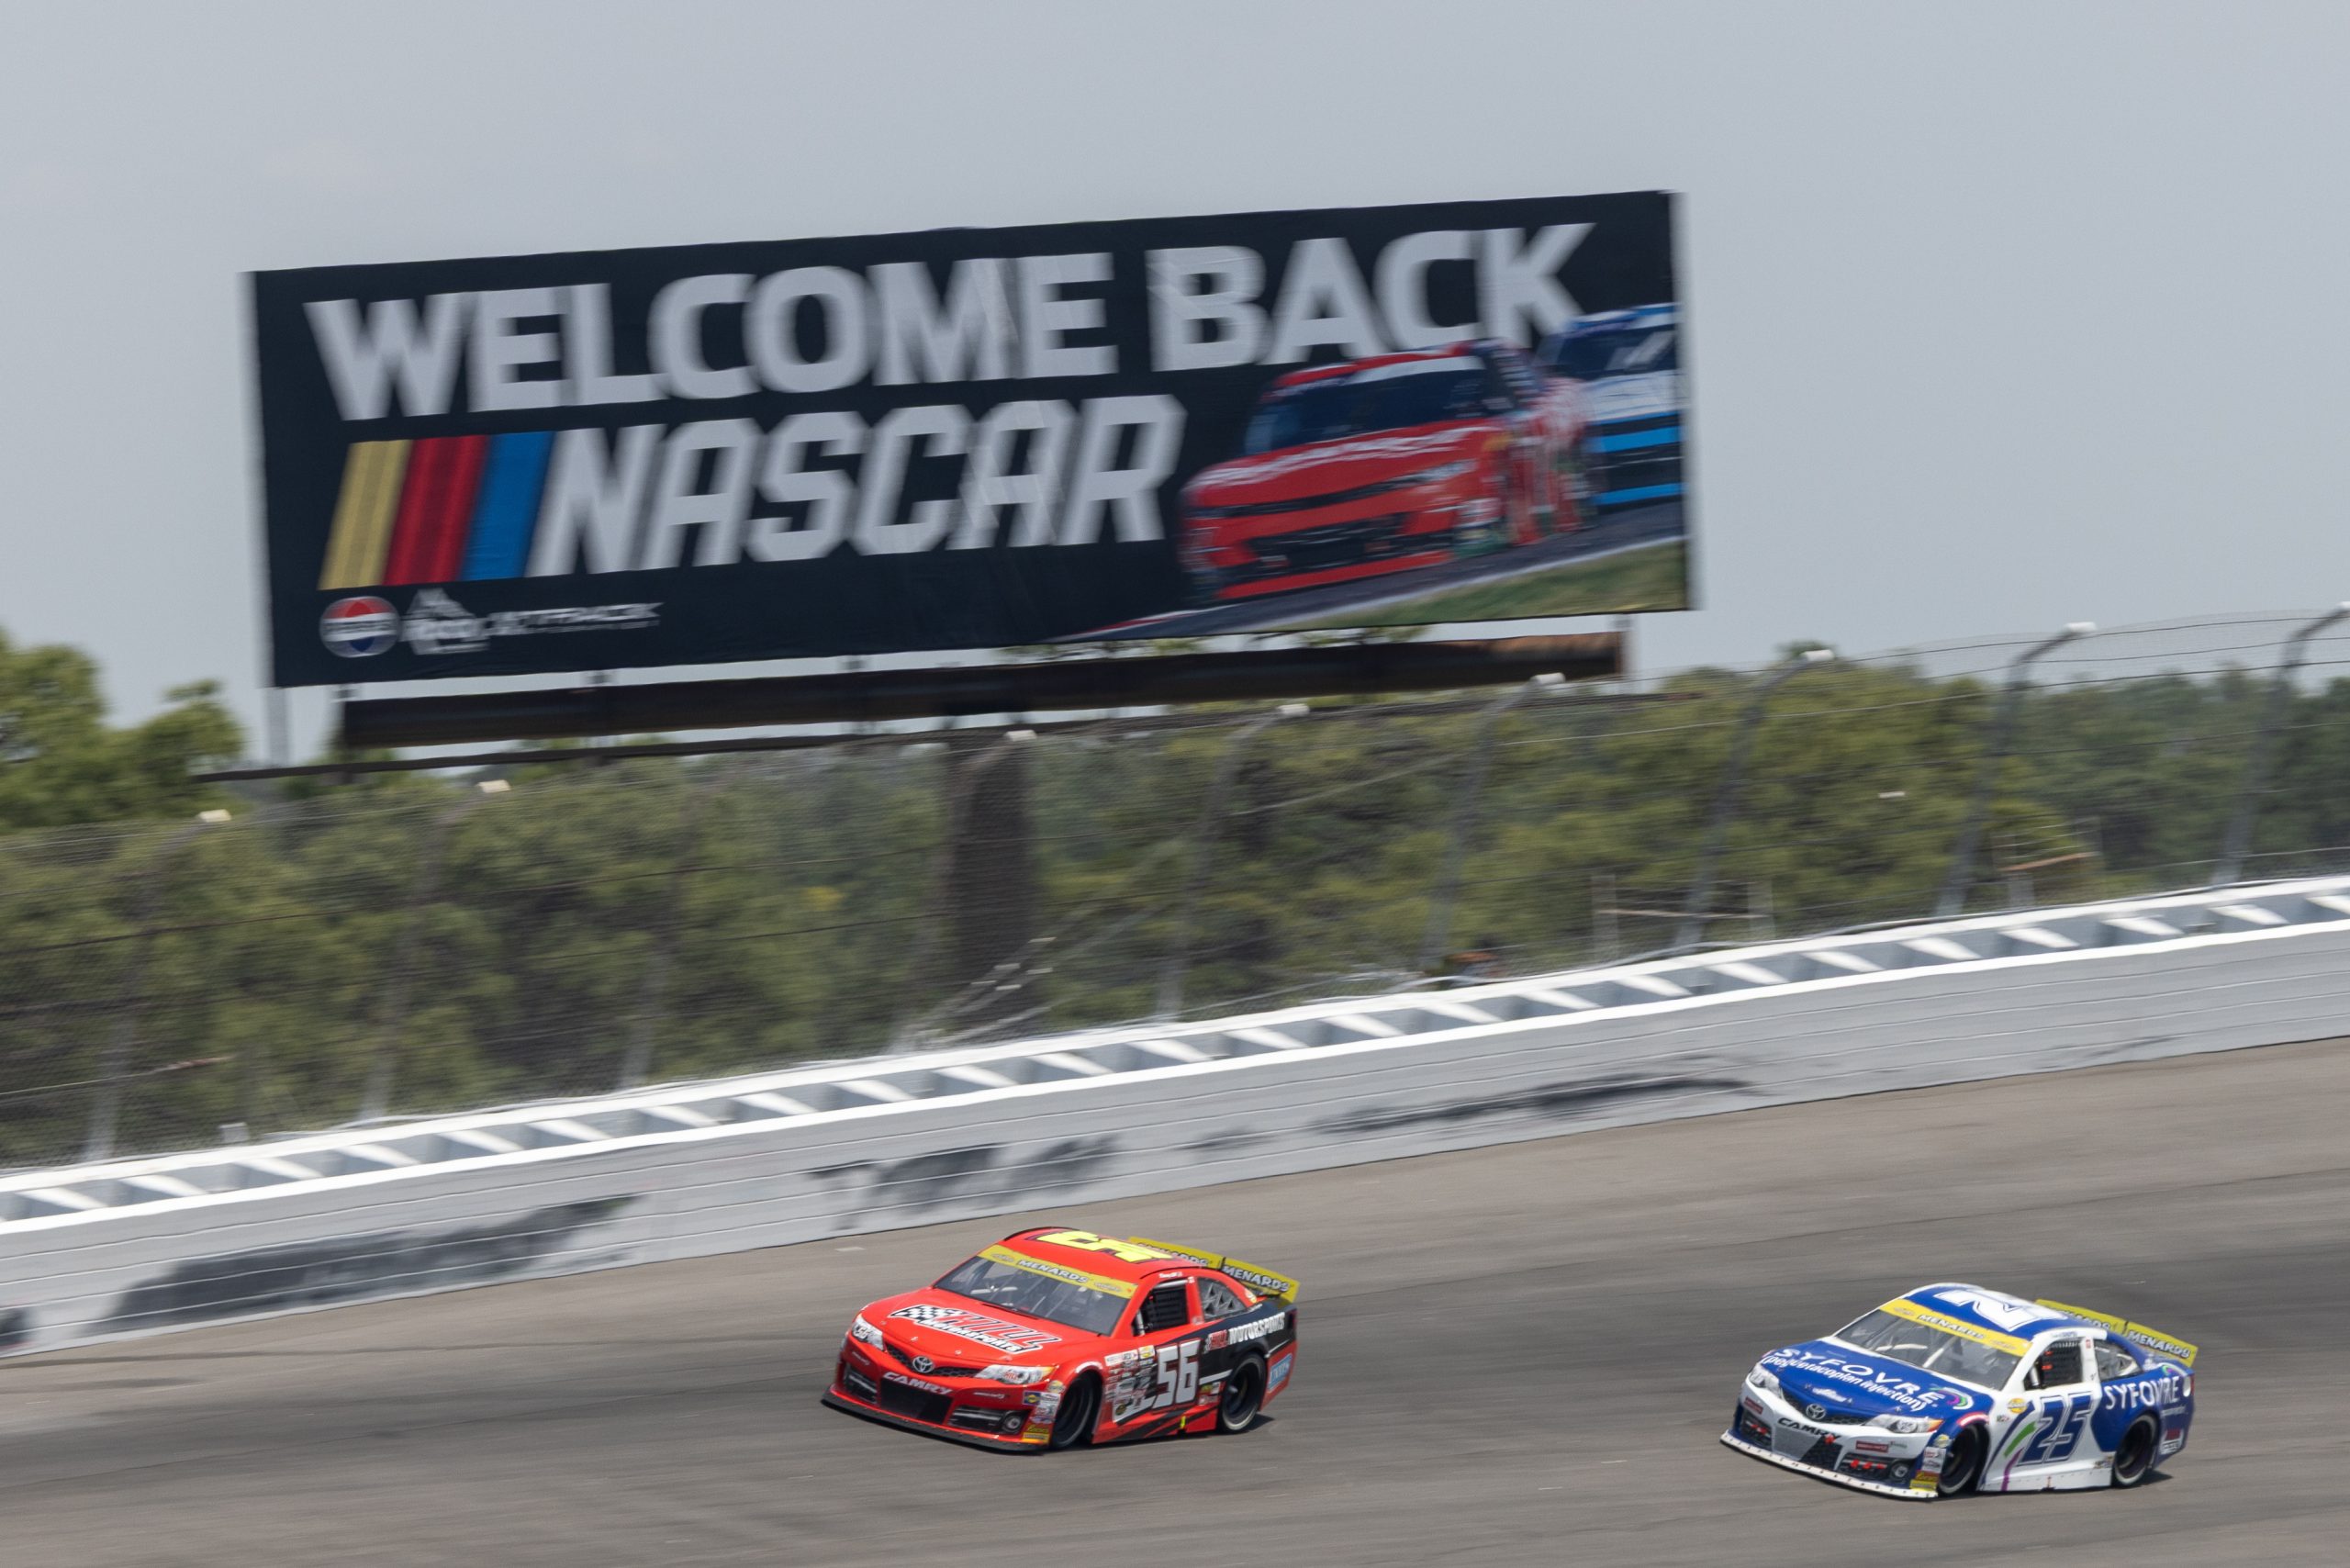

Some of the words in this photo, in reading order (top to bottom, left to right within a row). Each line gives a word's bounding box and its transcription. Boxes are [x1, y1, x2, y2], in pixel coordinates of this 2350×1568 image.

[304, 252, 1119, 420] WELCOME
[1145, 223, 1596, 371] BACK
[523, 395, 1187, 577] NASCAR
[1019, 1259, 1090, 1283] MENARDS
[1222, 1264, 1291, 1293] MENARDS
[1917, 1314, 1986, 1339] MENARDS
[2127, 1330, 2191, 1359] MENARDS
[883, 1372, 954, 1394] CAMRY
[1151, 1338, 1201, 1410] 56
[1774, 1348, 1946, 1405] SYFOVRE
[2104, 1376, 2180, 1410] SYFOVRE
[1777, 1417, 1841, 1440] CAMRY
[2018, 1392, 2093, 1466] 25
